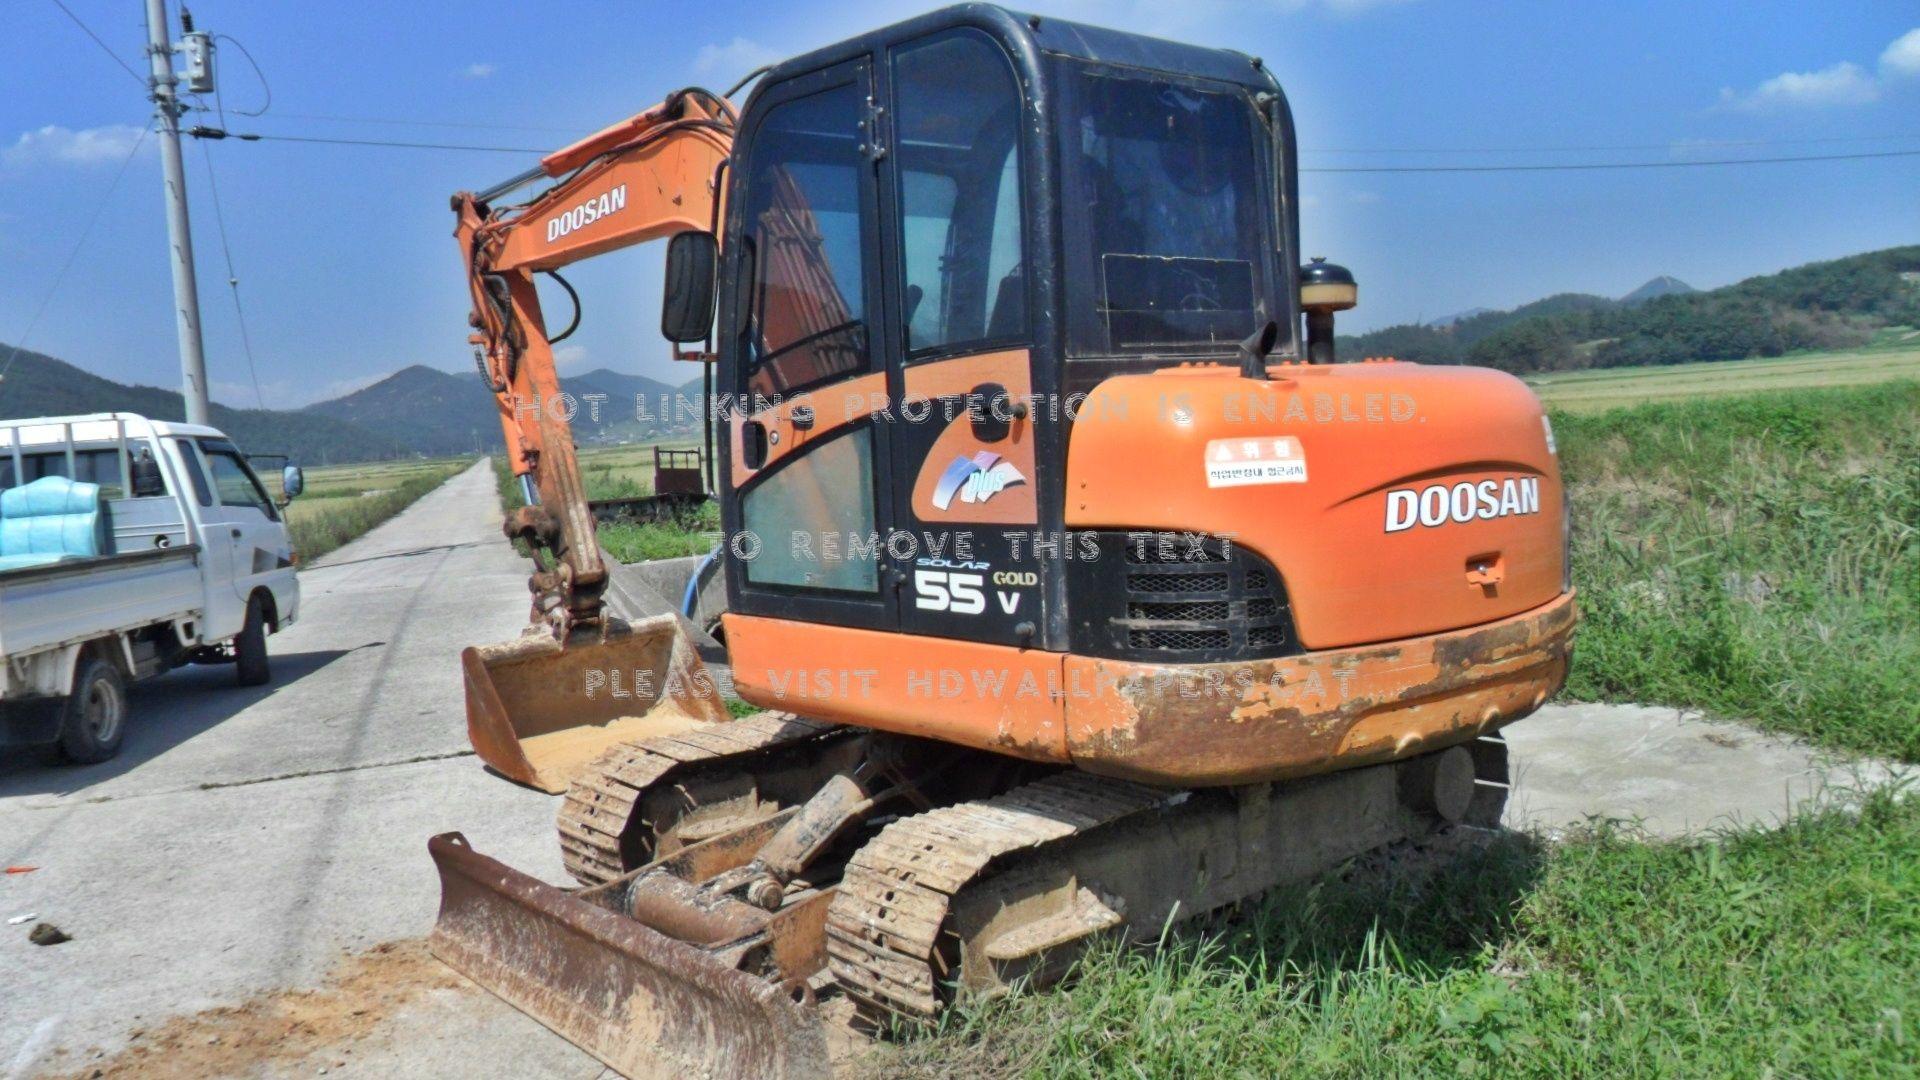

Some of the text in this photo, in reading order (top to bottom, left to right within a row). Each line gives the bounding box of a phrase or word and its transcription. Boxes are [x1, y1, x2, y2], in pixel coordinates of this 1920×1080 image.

[546, 184, 627, 243] DOOSAN
[1384, 477, 1540, 534] DOOSAN
[916, 558, 991, 570] SOLAR
[992, 571, 1038, 586] GOLD
[915, 570, 986, 615] 55
[997, 591, 1021, 615] V
